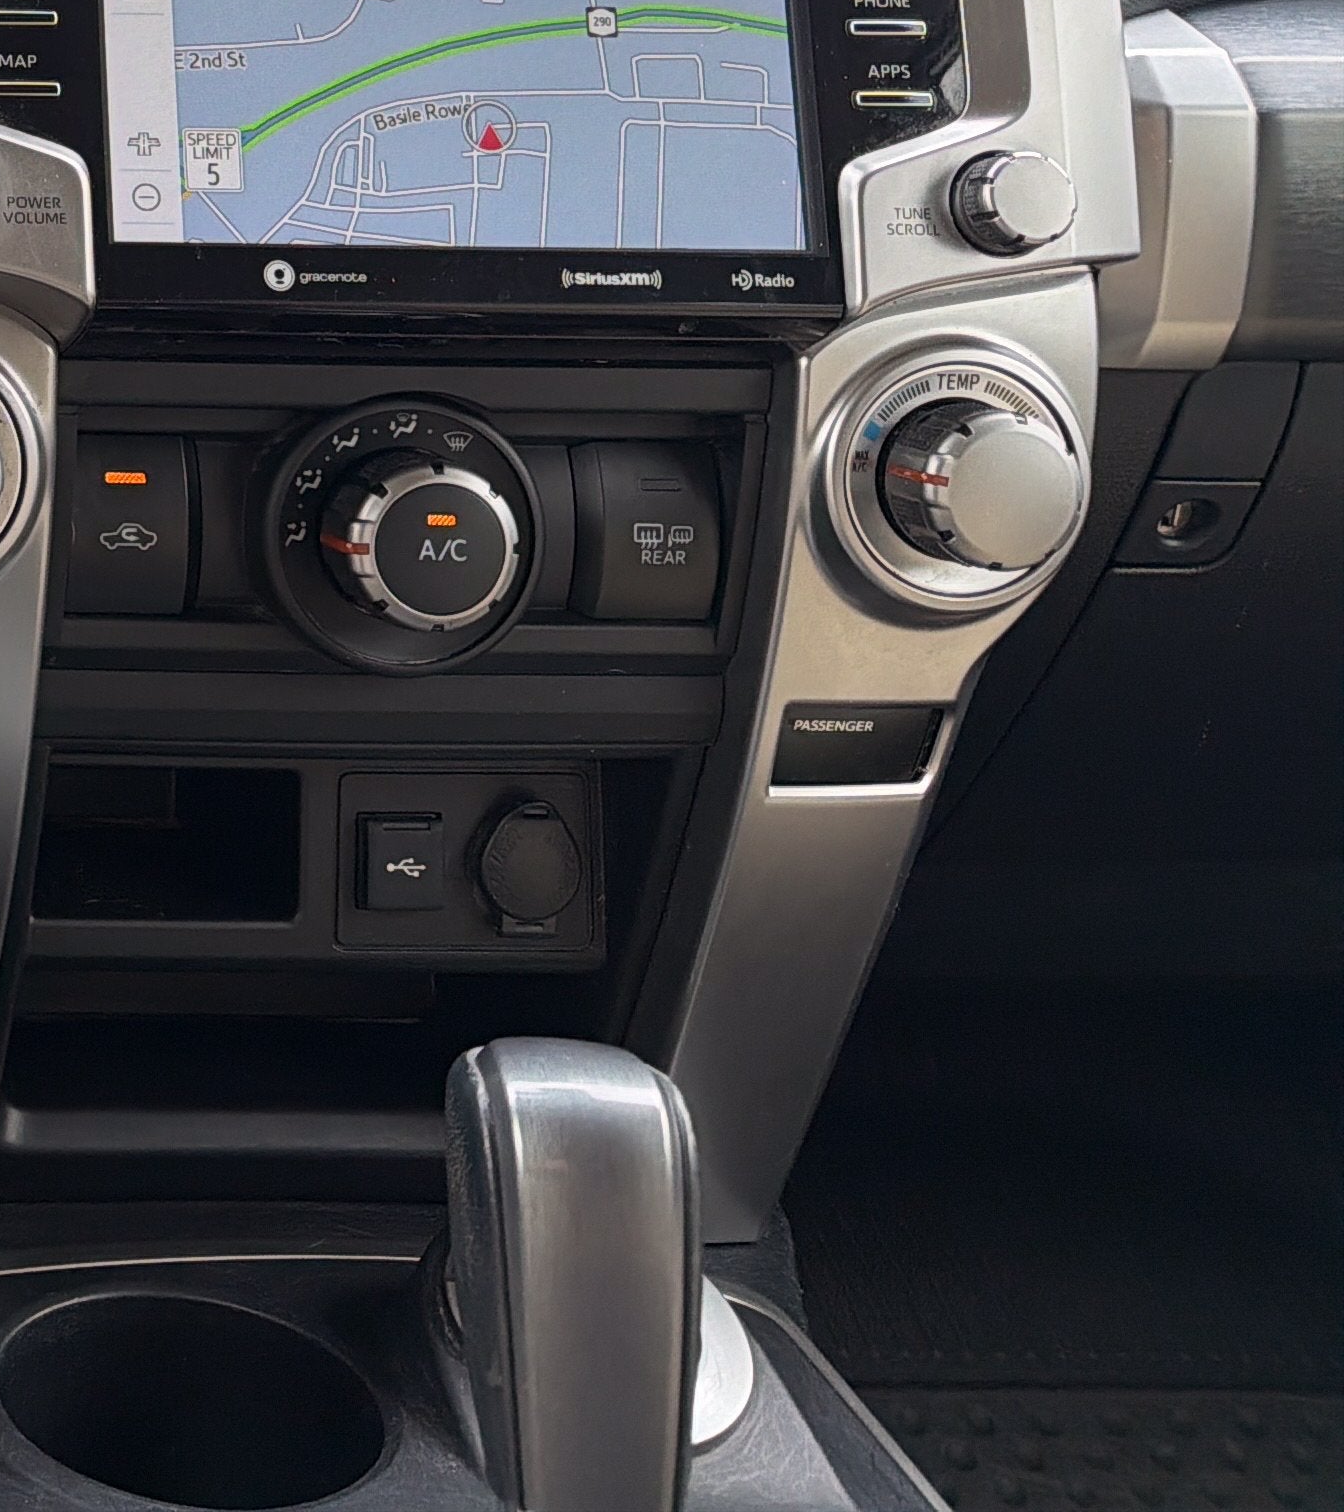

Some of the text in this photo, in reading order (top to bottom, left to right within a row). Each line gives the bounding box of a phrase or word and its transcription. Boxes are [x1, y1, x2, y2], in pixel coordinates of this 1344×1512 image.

[593, 15, 611, 28] 290
[188, 51, 222, 69] 2nd
[226, 51, 246, 68] St
[867, 64, 911, 79] APPS
[373, 106, 422, 131] Basile
[187, 132, 237, 147] SPEED
[192, 146, 233, 160] LIMIT
[207, 162, 220, 186] 5
[6, 196, 62, 210] POWER
[2, 211, 68, 226] VOLUME
[893, 207, 932, 220] TUNE
[886, 223, 941, 237] SCROLL
[299, 271, 368, 285] gracenote
[755, 274, 795, 288] Radio
[936, 373, 981, 391] TEMP
[418, 537, 468, 562] A/C
[640, 549, 686, 566] REAR
[793, 719, 874, 732] PASSENGER
